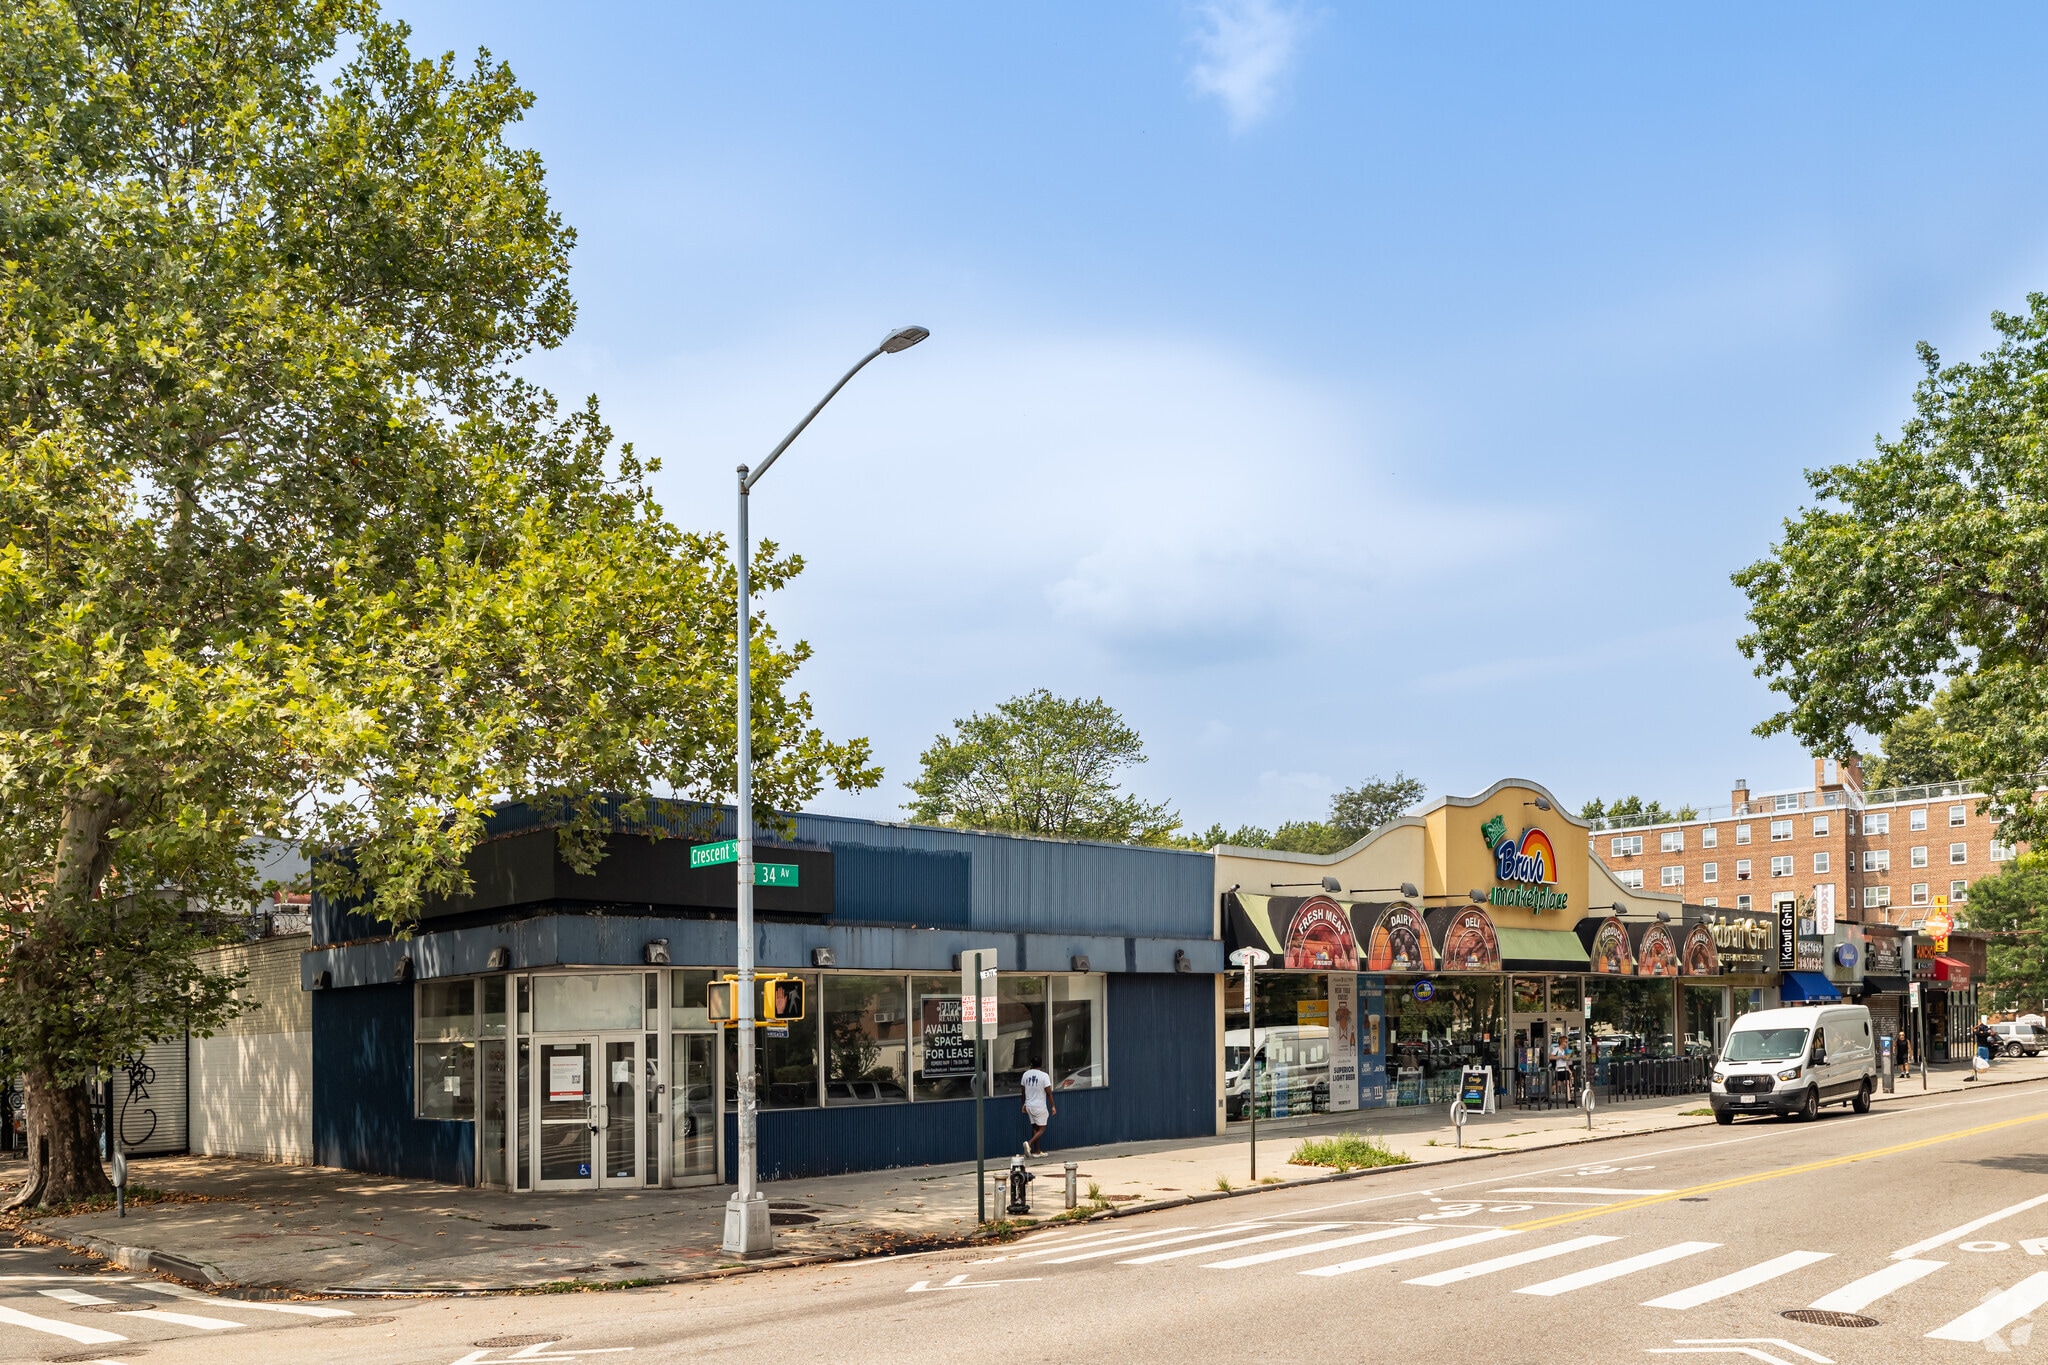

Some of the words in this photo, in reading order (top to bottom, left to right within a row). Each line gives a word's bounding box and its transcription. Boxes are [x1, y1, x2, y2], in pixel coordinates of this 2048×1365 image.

[692, 844, 730, 865] Crescent
[1498, 839, 1545, 884] Bravo
[763, 867, 776, 883] 34
[781, 868, 790, 878] Av
[1492, 884, 1568, 914] marketplace
[1298, 908, 1323, 935] FRESH
[1325, 909, 1346, 935] MEAT
[1390, 914, 1413, 927] DAIRY
[1465, 917, 1480, 928] DELI
[1782, 903, 1793, 926] Grill
[1601, 927, 1623, 943] PRODUCE
[1692, 934, 1709, 944] BAKERY
[1745, 918, 1773, 950] Grill
[1660, 932, 1672, 953] FOOD
[1782, 929, 1793, 960] Kabuli
[939, 1002, 959, 1016] PAPP
[925, 1023, 962, 1034] AVAILAB
[934, 1036, 962, 1047] SPACE
[925, 1049, 944, 1060] FOR
[946, 1048, 974, 1059] LEASE
[1332, 1074, 1345, 1082] LIGHT
[1345, 1073, 1356, 1081] BEER
[1333, 1066, 1355, 1074] SUPERIOR
